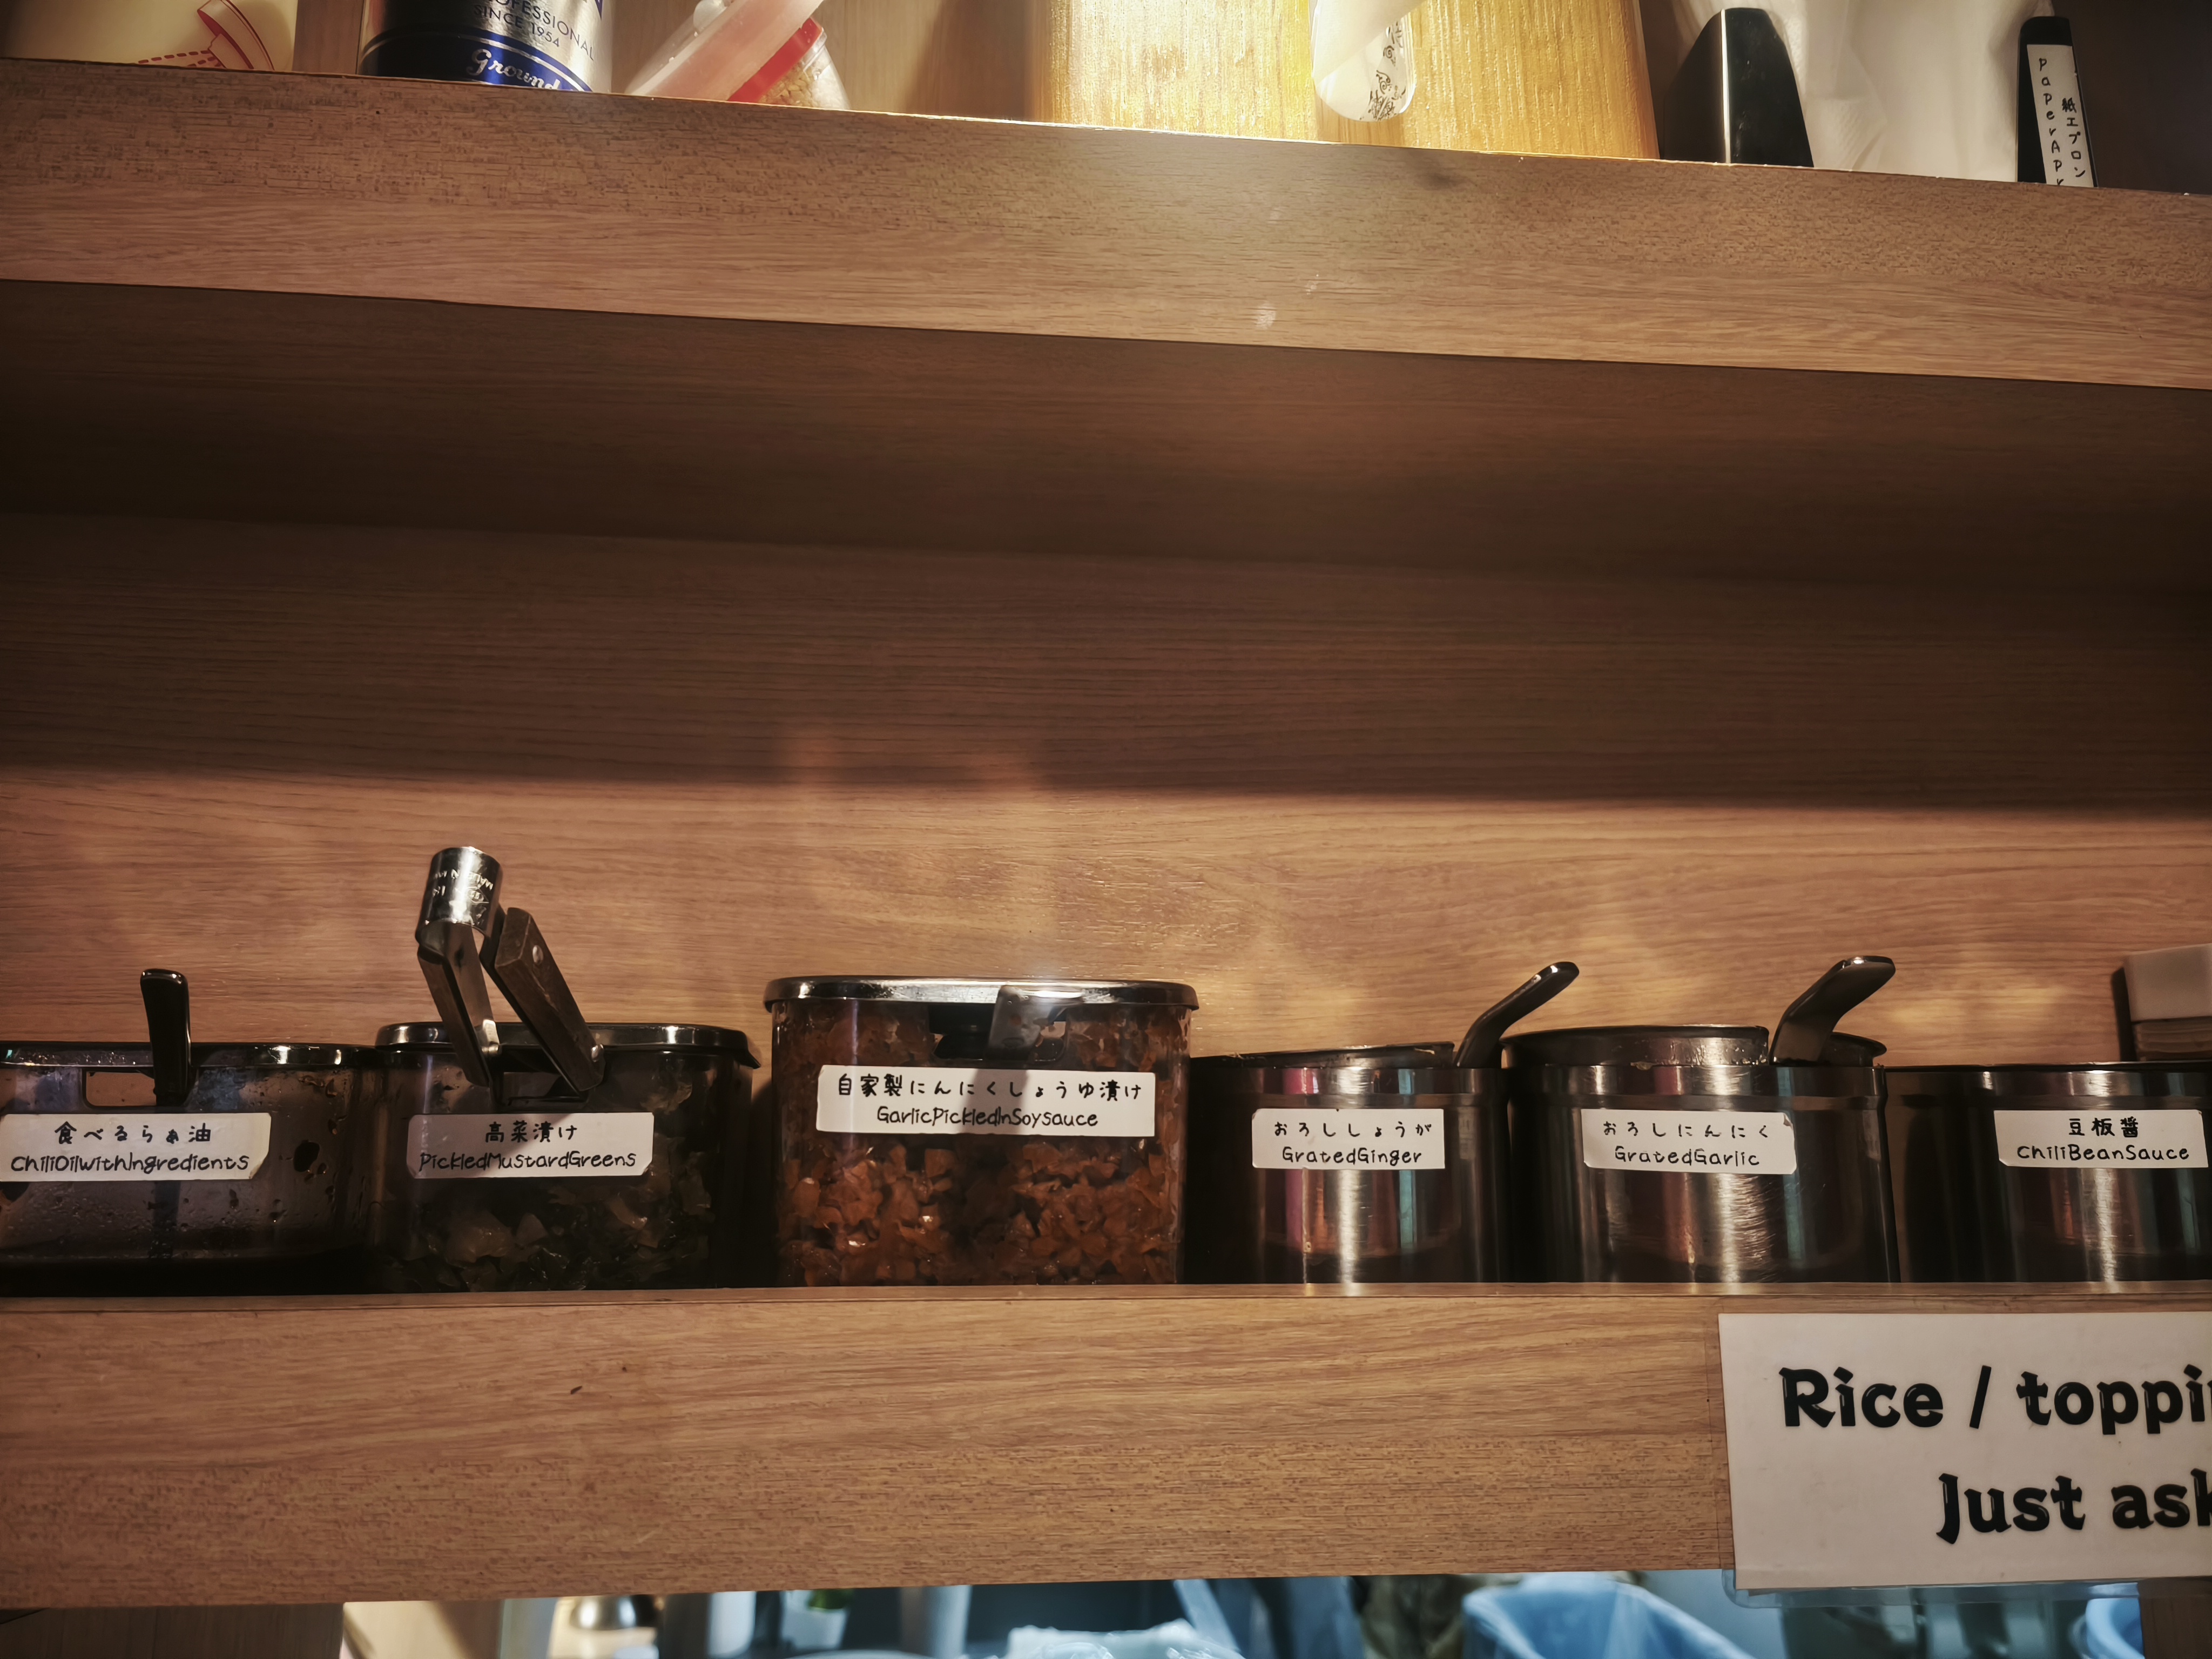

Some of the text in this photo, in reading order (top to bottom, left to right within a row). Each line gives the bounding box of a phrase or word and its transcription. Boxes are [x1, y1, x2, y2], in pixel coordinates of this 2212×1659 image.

[474, 4, 560, 48] SINCE 1954
[838, 1073, 1141, 1102] 自家製にんにくしょうゆ漬け
[485, 1120, 578, 1143] 高菜漬け
[1274, 1121, 1432, 1138] おろししょうが
[1603, 1121, 1769, 1138] おろしにんにく
[1282, 1146, 1422, 1166] GratedGinger
[1615, 1145, 1760, 1167] GratedGarlic
[2017, 1144, 2189, 1161] ChiliBeanSauce
[1778, 1364, 2212, 1435] Rice / toppi
[1936, 1473, 2086, 1545] Just
